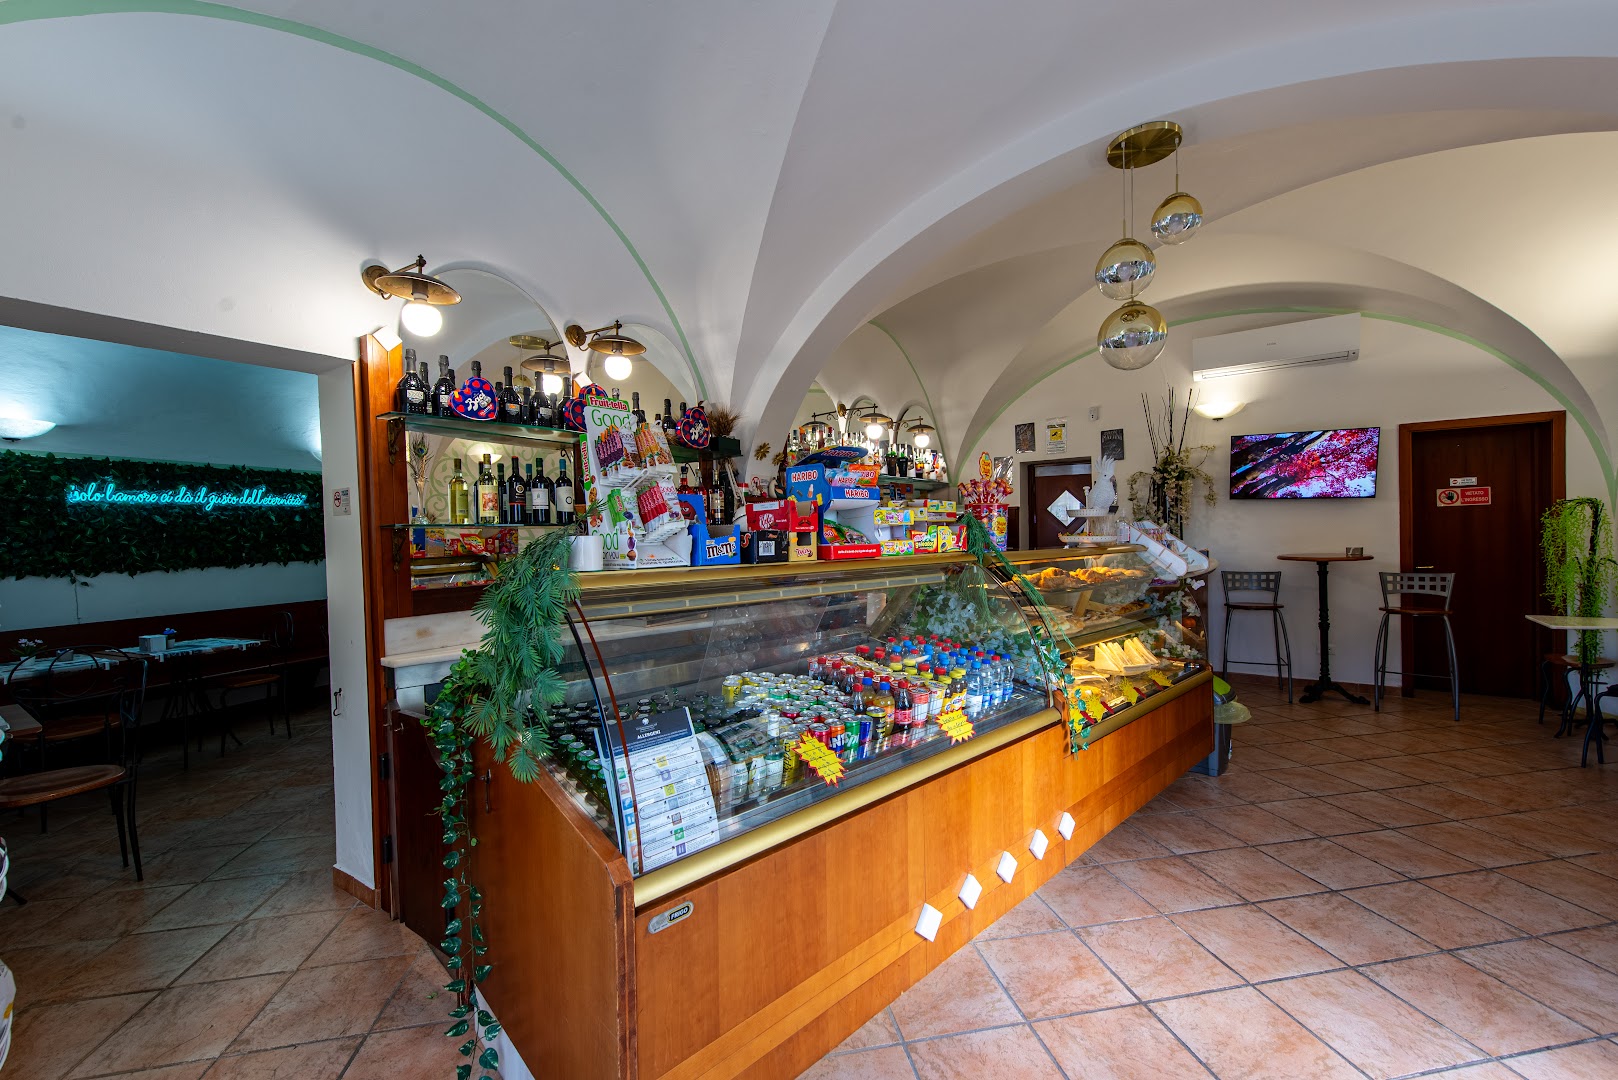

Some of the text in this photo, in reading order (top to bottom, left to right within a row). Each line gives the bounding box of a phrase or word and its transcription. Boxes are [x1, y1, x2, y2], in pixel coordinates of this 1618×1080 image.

[589, 395, 628, 411] Fruit-tella
[580, 441, 591, 482] Fruit-tella
[791, 469, 818, 482] HARIBO
[194, 486, 207, 504] il
[205, 493, 239, 511] gusto
[844, 488, 869, 499] HARIBO
[637, 731, 666, 743] ALLERGENI
